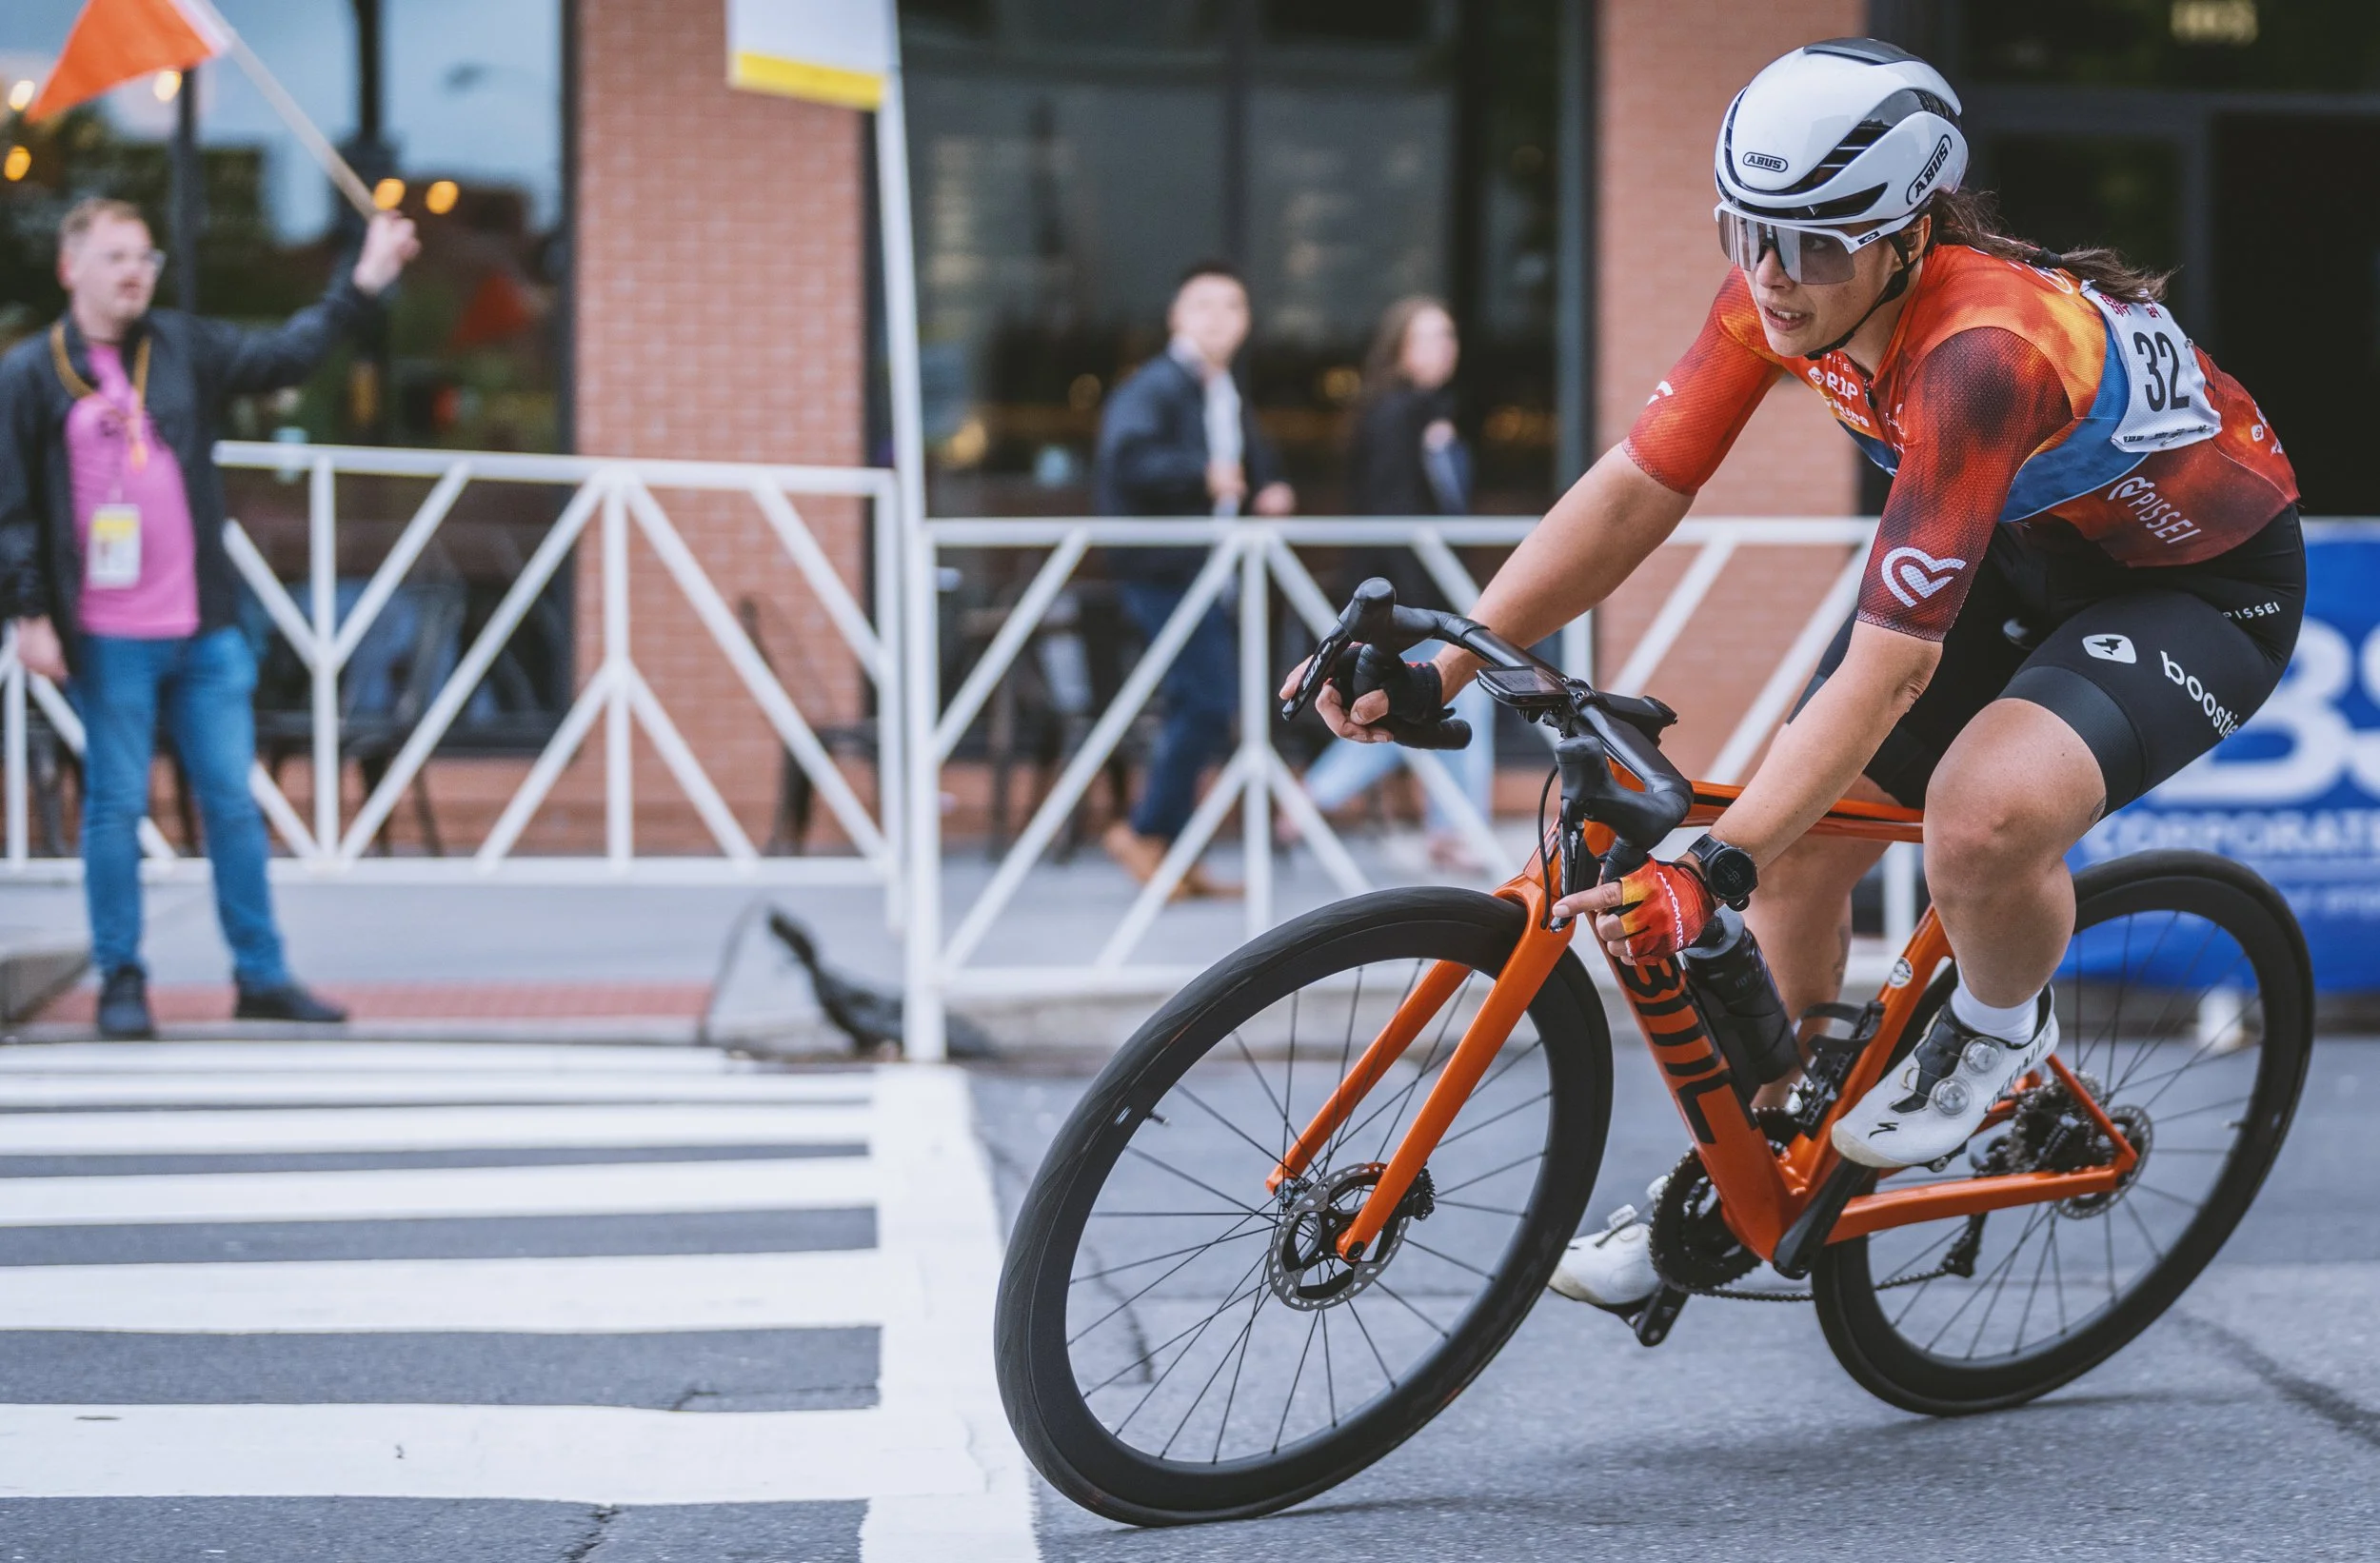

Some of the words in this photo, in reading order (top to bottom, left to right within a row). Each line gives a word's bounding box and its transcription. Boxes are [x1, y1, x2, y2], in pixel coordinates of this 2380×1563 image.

[1747, 155, 1783, 170] ABUS
[1915, 143, 1950, 199] ABUS
[1826, 353, 1853, 374] PIEI
[2132, 331, 2191, 412] 32
[2128, 492, 2202, 544] PISSEI
[1656, 870, 1684, 950] AUTOMATIC
[1618, 952, 1759, 1144] BMC
